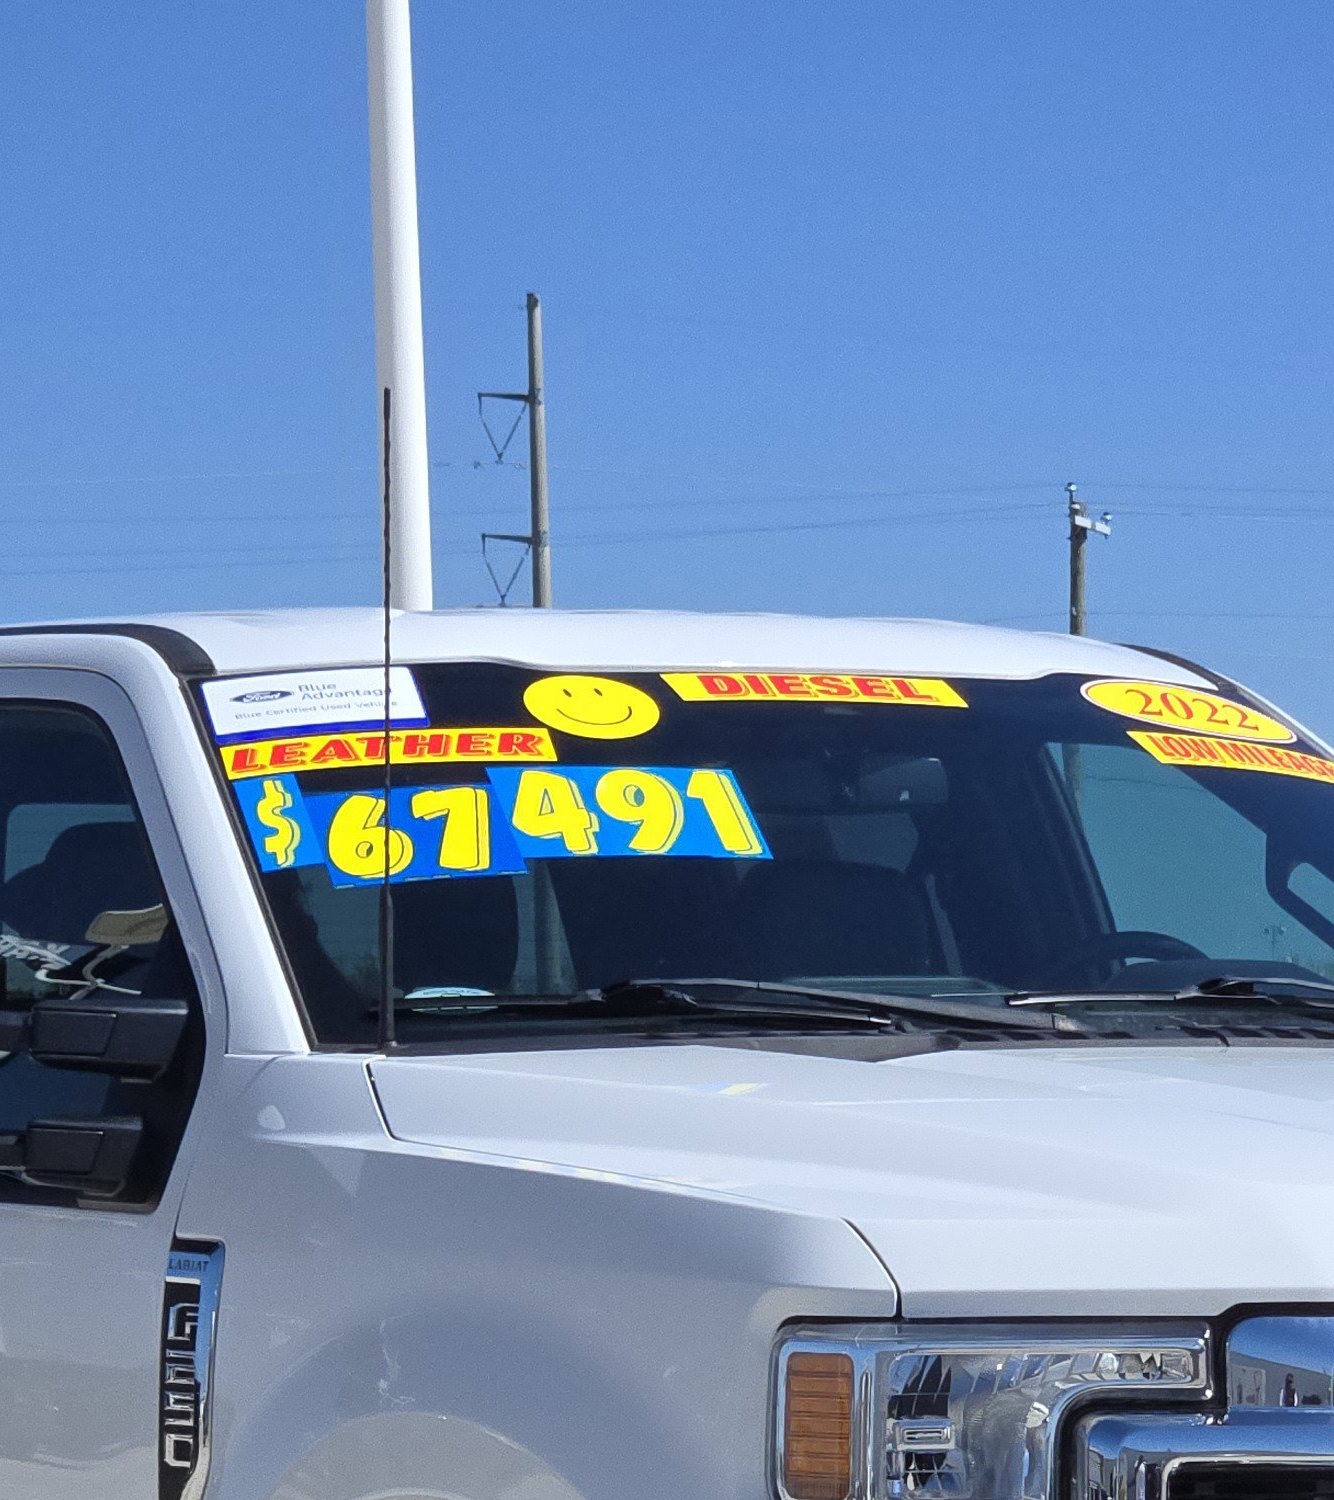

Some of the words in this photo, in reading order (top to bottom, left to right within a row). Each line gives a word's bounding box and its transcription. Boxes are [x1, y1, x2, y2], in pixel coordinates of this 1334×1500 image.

[298, 683, 337, 693] Blue
[695, 674, 940, 702] DIESEL
[1125, 688, 1259, 731] 2022
[231, 732, 546, 772] LEATHER
[1146, 734, 1223, 763] LOW
